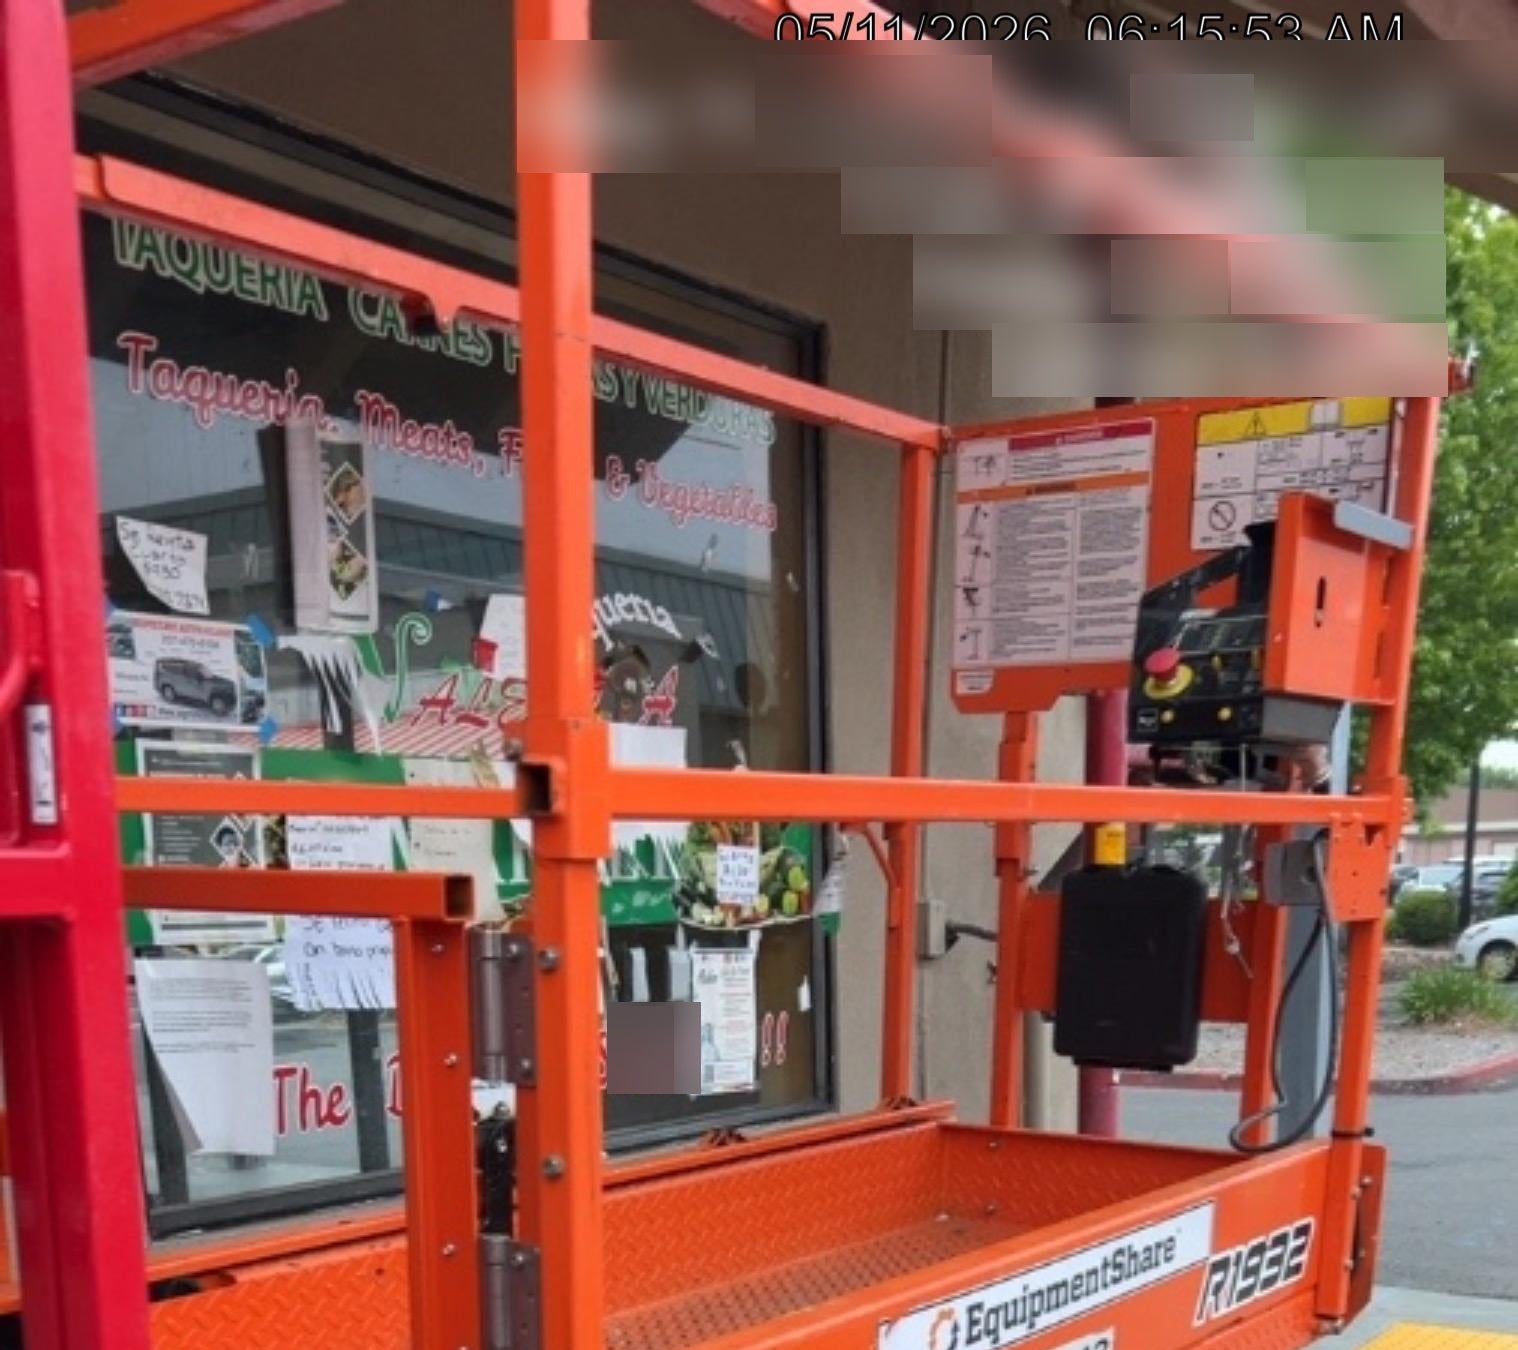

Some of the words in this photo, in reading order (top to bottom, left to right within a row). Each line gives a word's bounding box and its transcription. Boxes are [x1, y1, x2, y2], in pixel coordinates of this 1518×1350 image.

[635, 459, 778, 532] Vegetables
[272, 1063, 351, 1136] The
[965, 1235, 1177, 1346] EquipmentShare
[1194, 1219, 1315, 1325] R1932
